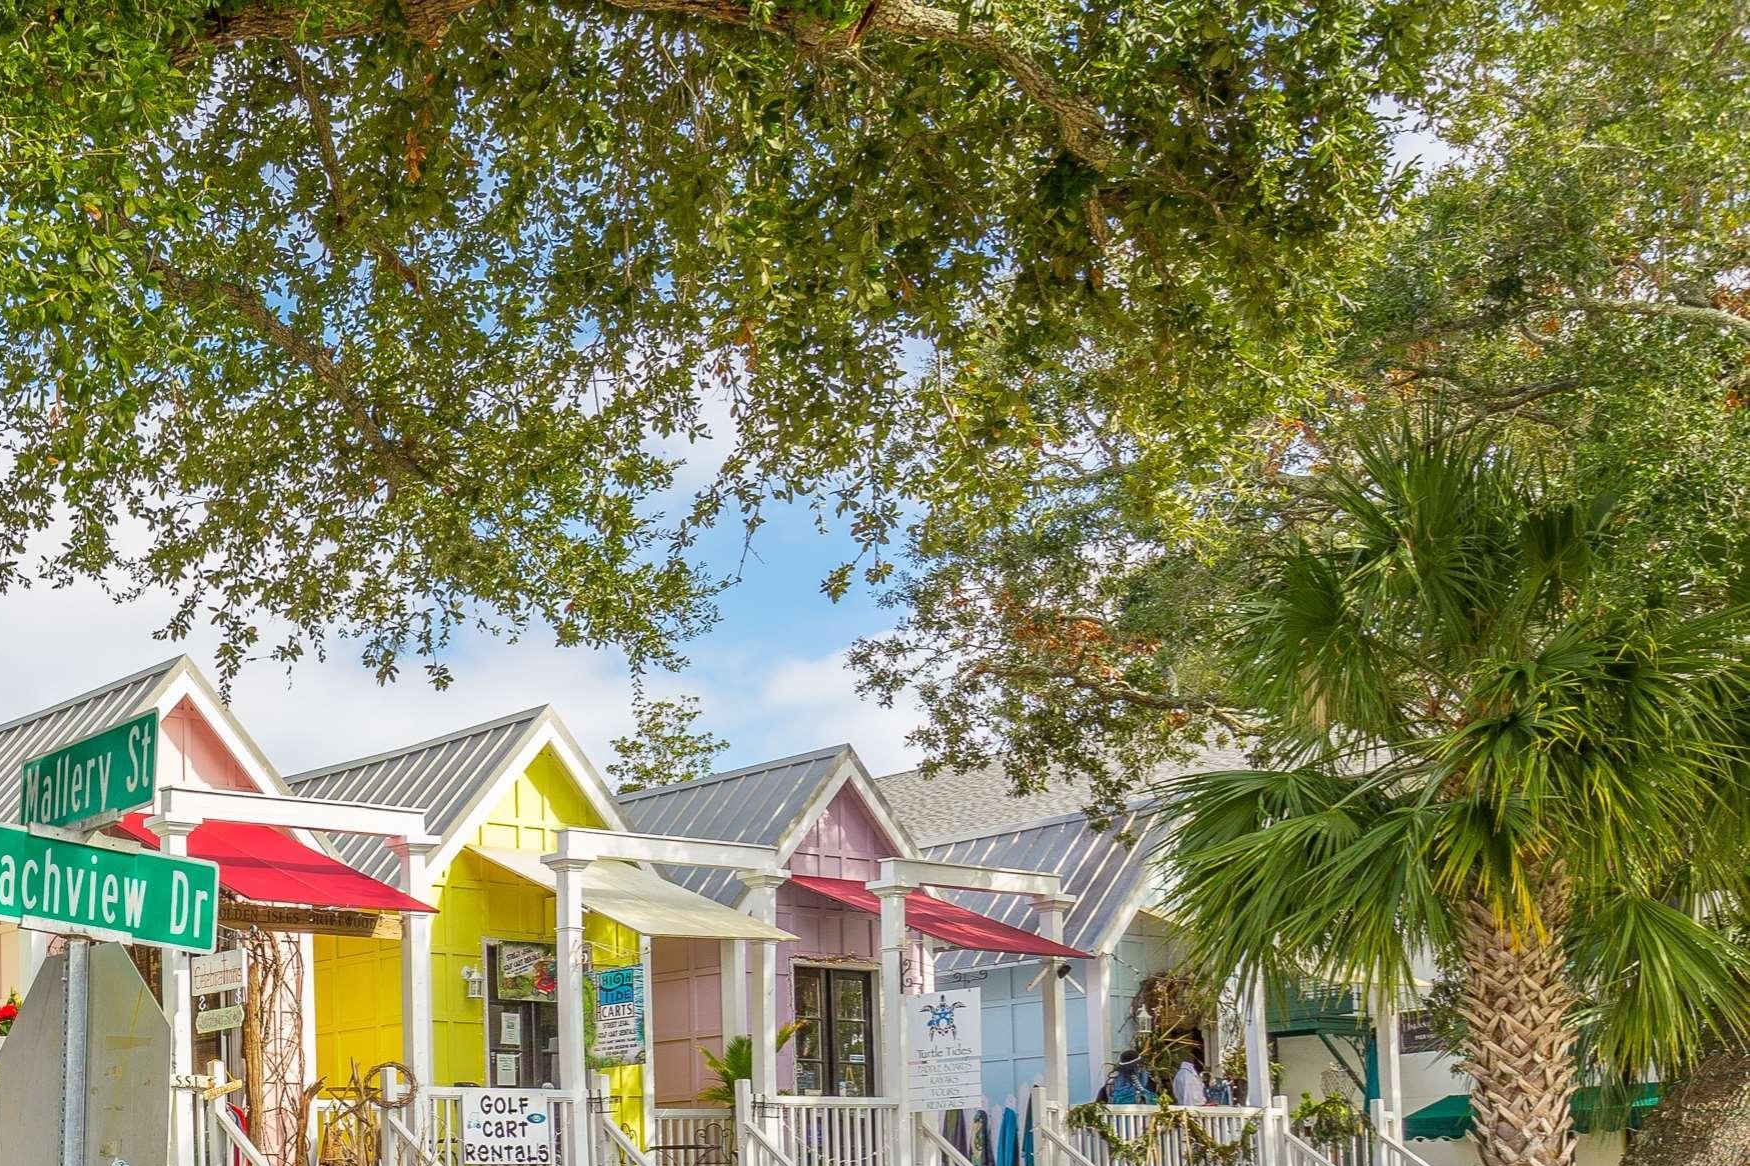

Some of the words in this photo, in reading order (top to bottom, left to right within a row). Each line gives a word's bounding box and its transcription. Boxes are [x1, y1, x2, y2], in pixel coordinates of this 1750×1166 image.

[25, 752, 111, 824] Mallery
[126, 722, 151, 792] St
[169, 870, 209, 938] Dr
[218, 907, 258, 921] OLDEN
[266, 910, 299, 924] ISLES
[602, 972, 633, 986] HIGH
[604, 989, 633, 1004] TIDE
[602, 1004, 632, 1018] CARTS
[916, 1044, 944, 1059] Turtle
[946, 1042, 973, 1056] Tides
[930, 1087, 961, 1097] TOURS
[480, 1095, 529, 1115] GOLF
[926, 1101, 964, 1110] RENTALS
